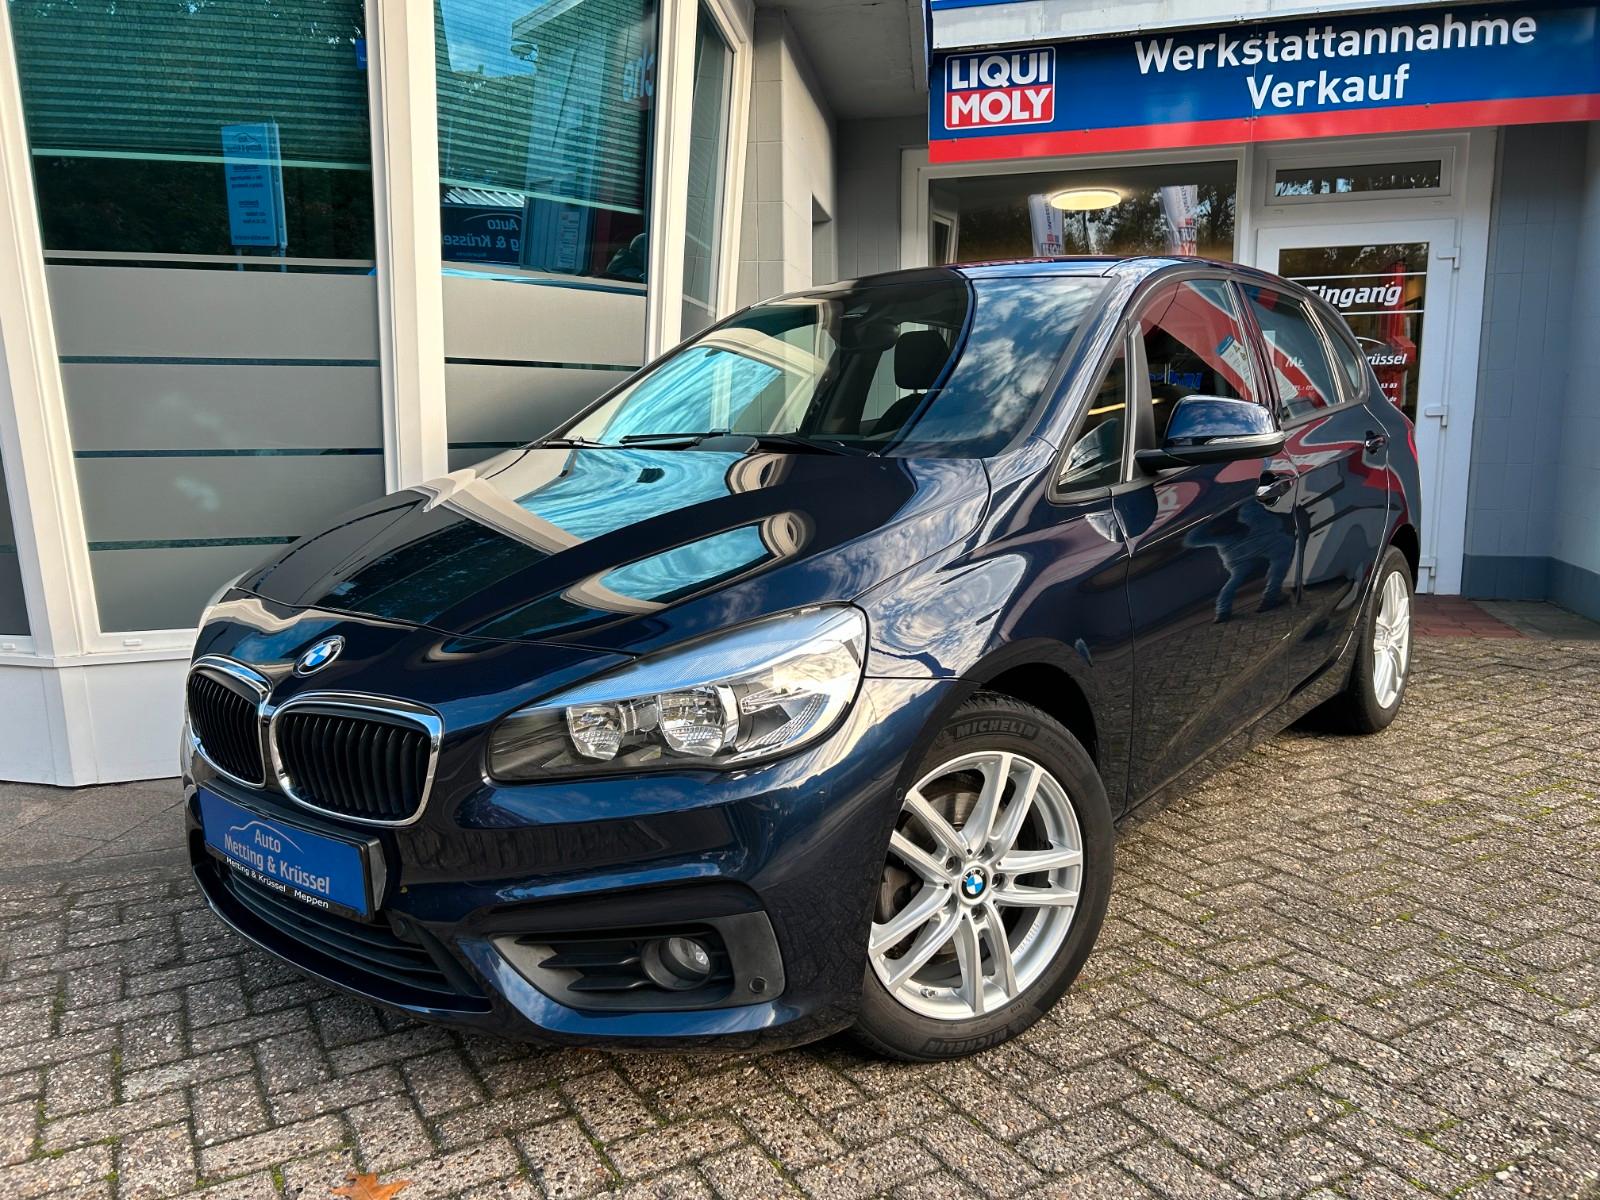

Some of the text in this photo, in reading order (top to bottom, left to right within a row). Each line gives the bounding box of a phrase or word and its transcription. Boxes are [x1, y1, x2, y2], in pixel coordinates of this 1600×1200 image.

[1134, 13, 1537, 74] Werkstattannahme
[952, 52, 1049, 90] LIQUI
[1246, 63, 1410, 110] Verkauf
[951, 88, 1052, 124] MOLY
[1366, 353, 1408, 366] rüssel
[956, 719, 1038, 738] MICHELIN
[255, 829, 281, 854] Auto
[224, 833, 330, 895] Metting & Krüssel
[258, 873, 286, 893] Krüssel
[294, 889, 329, 909] Meppen
